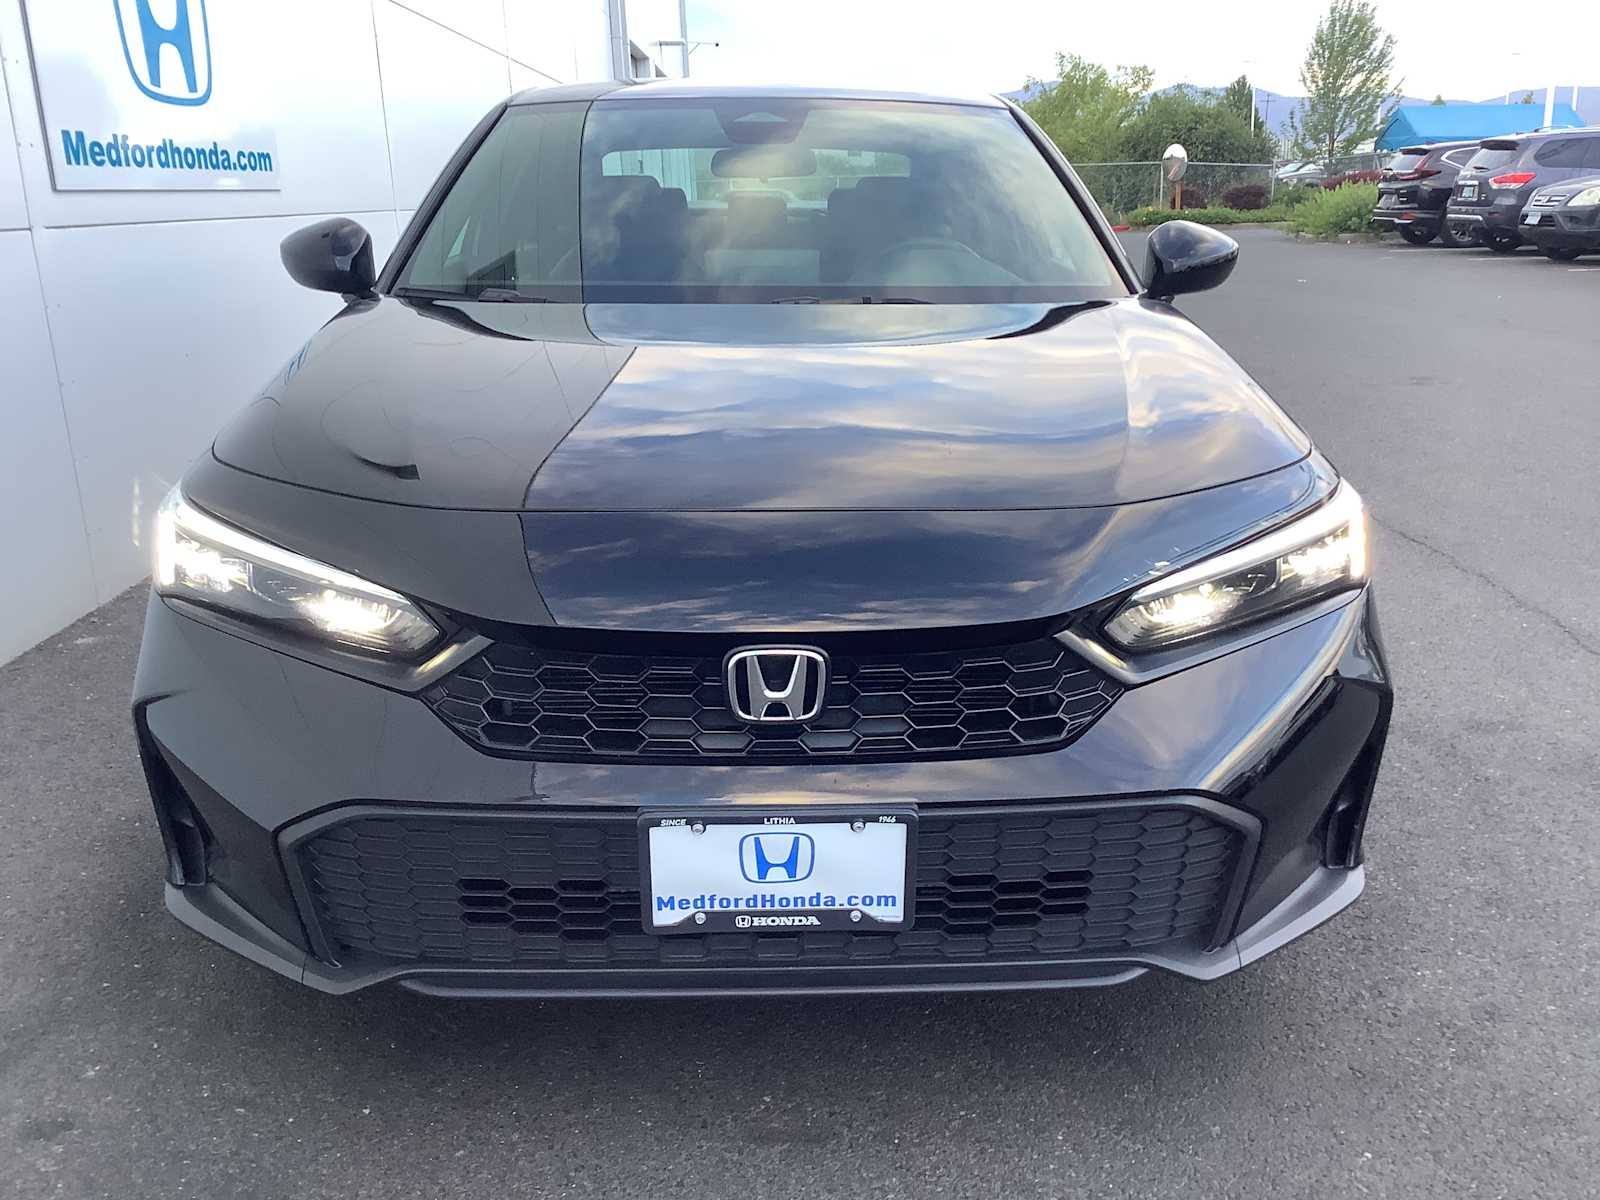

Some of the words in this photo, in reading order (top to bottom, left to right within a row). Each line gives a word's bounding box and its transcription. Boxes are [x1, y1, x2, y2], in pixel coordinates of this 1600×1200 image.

[61, 129, 273, 172] Medfordhonda.com
[660, 818, 687, 827] SINCE
[763, 816, 796, 825] LITHIA
[878, 815, 896, 823] 1966
[656, 892, 897, 911] MedfordHonda.com
[751, 915, 821, 927] HONDA
